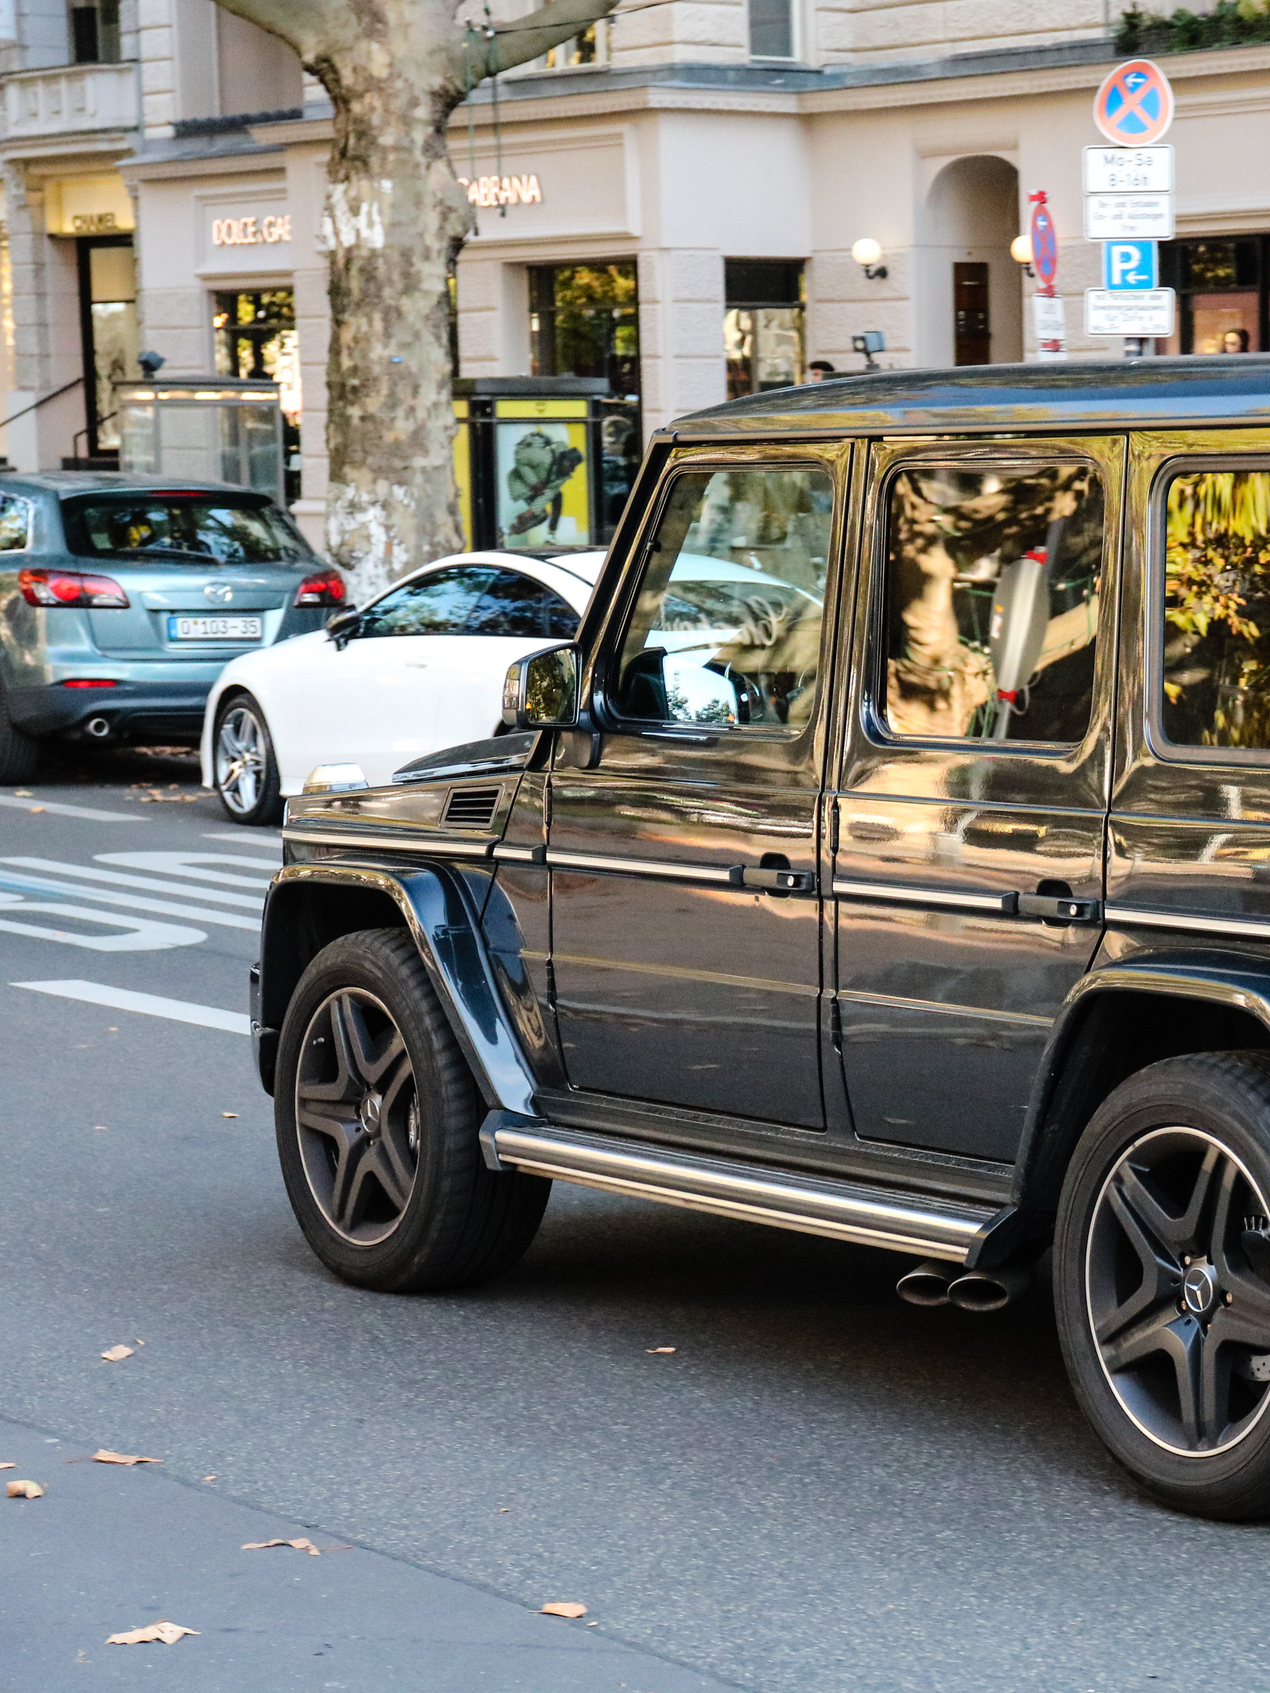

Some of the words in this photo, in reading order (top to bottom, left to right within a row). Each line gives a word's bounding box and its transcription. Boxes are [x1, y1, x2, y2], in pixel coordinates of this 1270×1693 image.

[1103, 152, 1154, 167] Mo-Sa
[1110, 244, 1142, 285] P
[201, 620, 258, 634] 103-35
